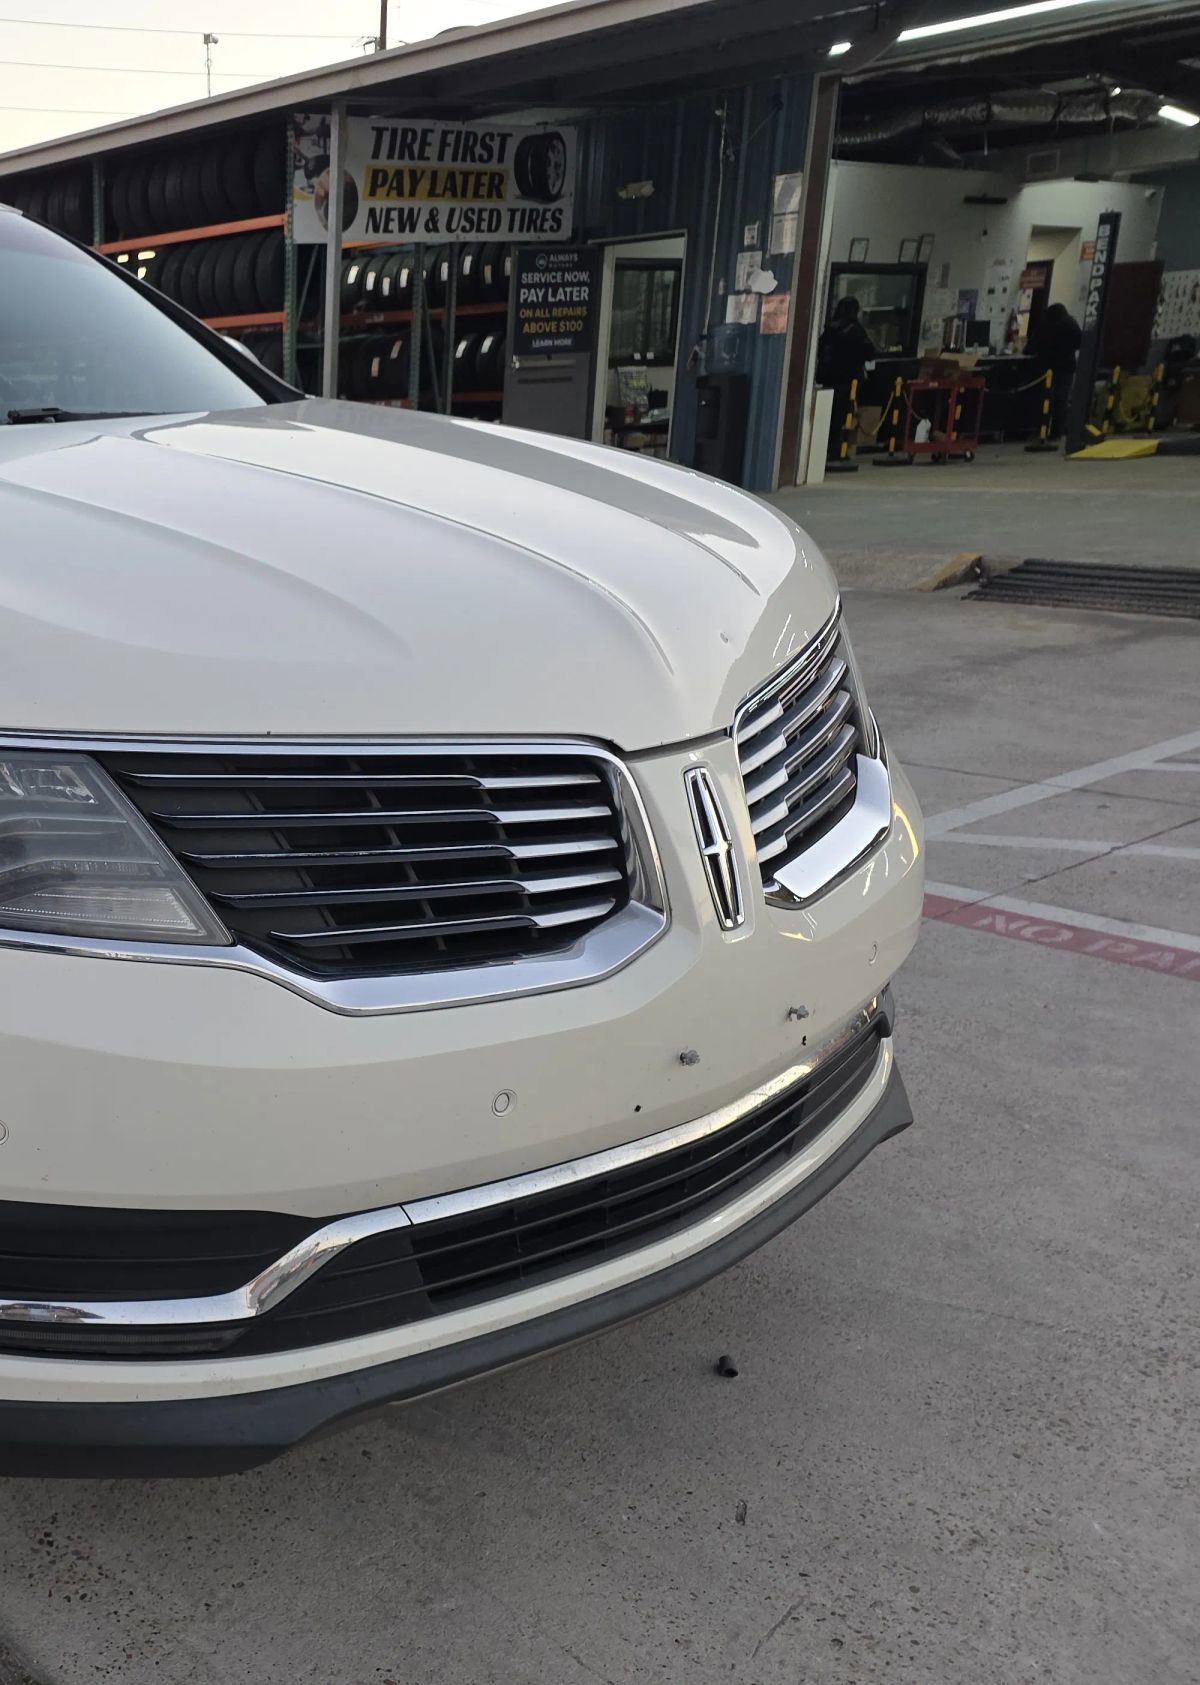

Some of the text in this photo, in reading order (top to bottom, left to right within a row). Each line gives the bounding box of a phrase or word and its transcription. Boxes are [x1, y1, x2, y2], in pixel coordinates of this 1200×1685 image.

[371, 126, 513, 164] TIRE FIRST
[368, 168, 505, 199] PAY LATER
[365, 207, 564, 234] NEW & USED TIRES
[521, 272, 562, 284] SERVICE
[1085, 224, 1111, 315] BENDPAK
[520, 286, 589, 303] PAY LATER
[520, 306, 588, 319] ON ALL REPAIRS
[523, 320, 583, 334] ABOVE $100
[532, 338, 572, 348] LEARN MORE
[973, 914, 1200, 975] NO PA
